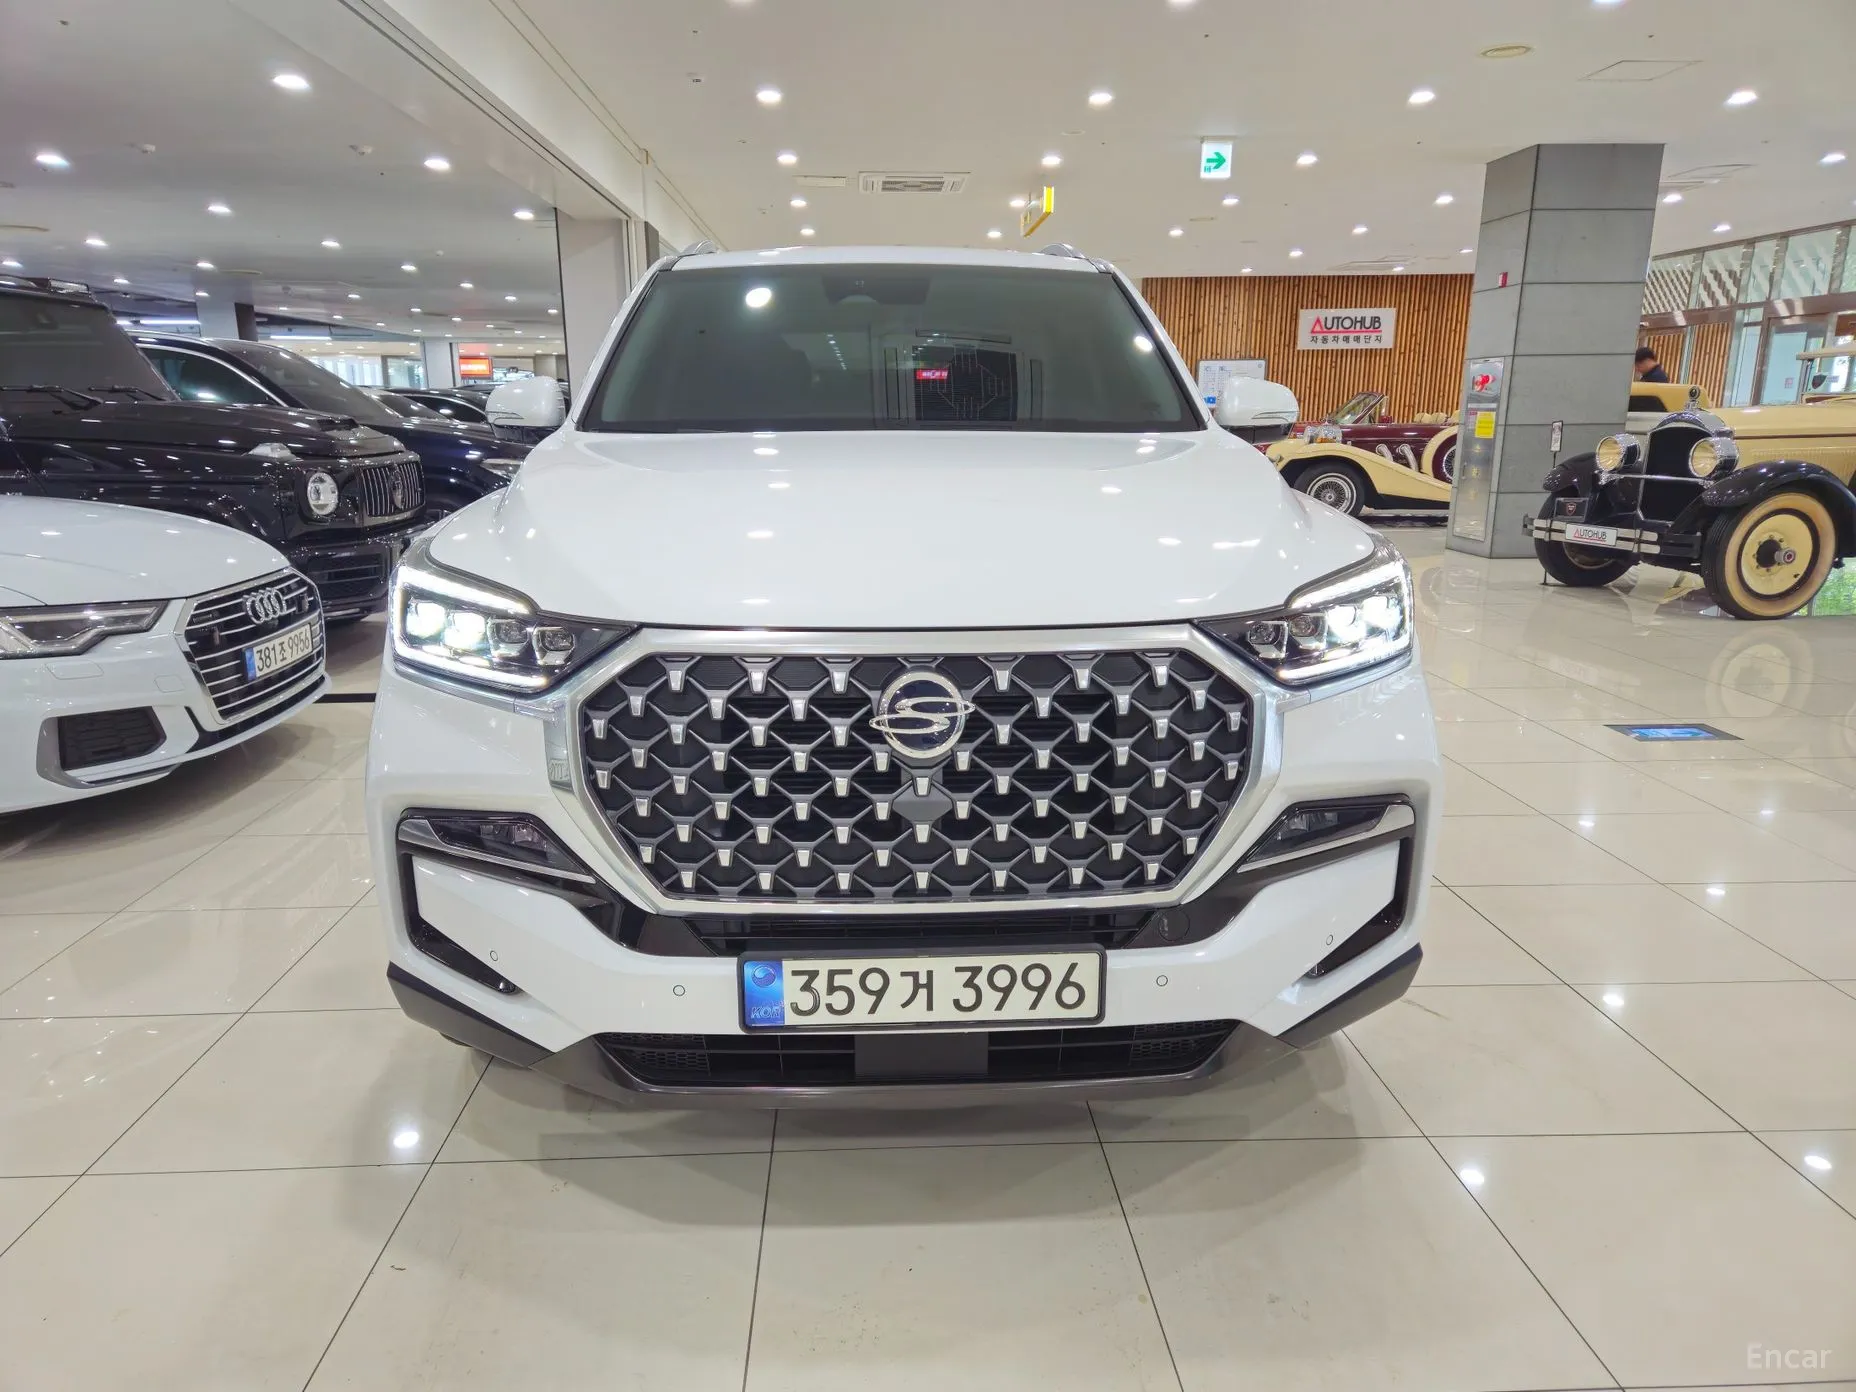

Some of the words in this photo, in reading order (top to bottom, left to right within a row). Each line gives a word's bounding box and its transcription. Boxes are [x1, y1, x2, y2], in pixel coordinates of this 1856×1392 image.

[1311, 315, 1382, 333] AUTOHUB
[1310, 335, 1382, 344] 자동차매매단지
[1573, 529, 1607, 541] AUTOHUB
[256, 641, 287, 672] 381조
[288, 628, 310, 658] 9956
[790, 966, 934, 1016] 359거
[952, 962, 1086, 1013] 3996
